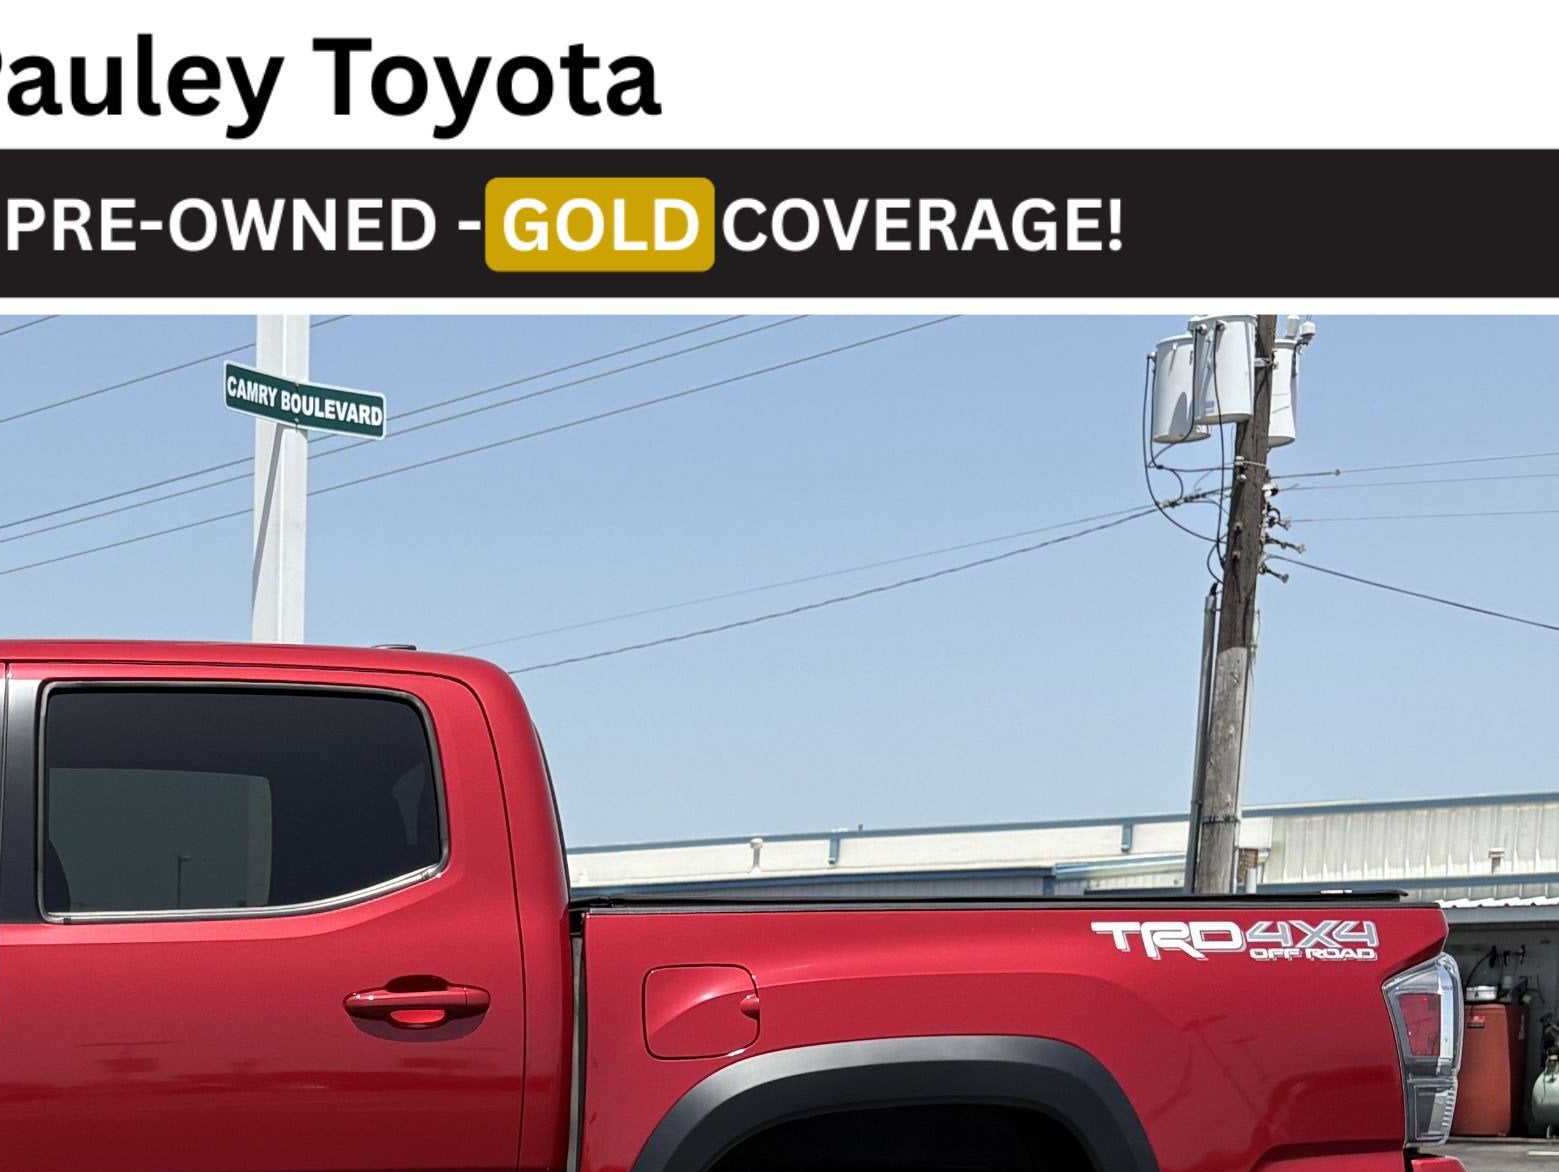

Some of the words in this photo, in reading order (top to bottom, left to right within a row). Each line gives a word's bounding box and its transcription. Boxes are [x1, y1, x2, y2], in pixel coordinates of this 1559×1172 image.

[226, 375, 279, 408] CAMRY
[280, 389, 383, 426] BOULEVARD
[1090, 921, 1245, 961] TRD
[1249, 947, 1302, 961] OFF
[1303, 947, 1378, 961] ROAD
